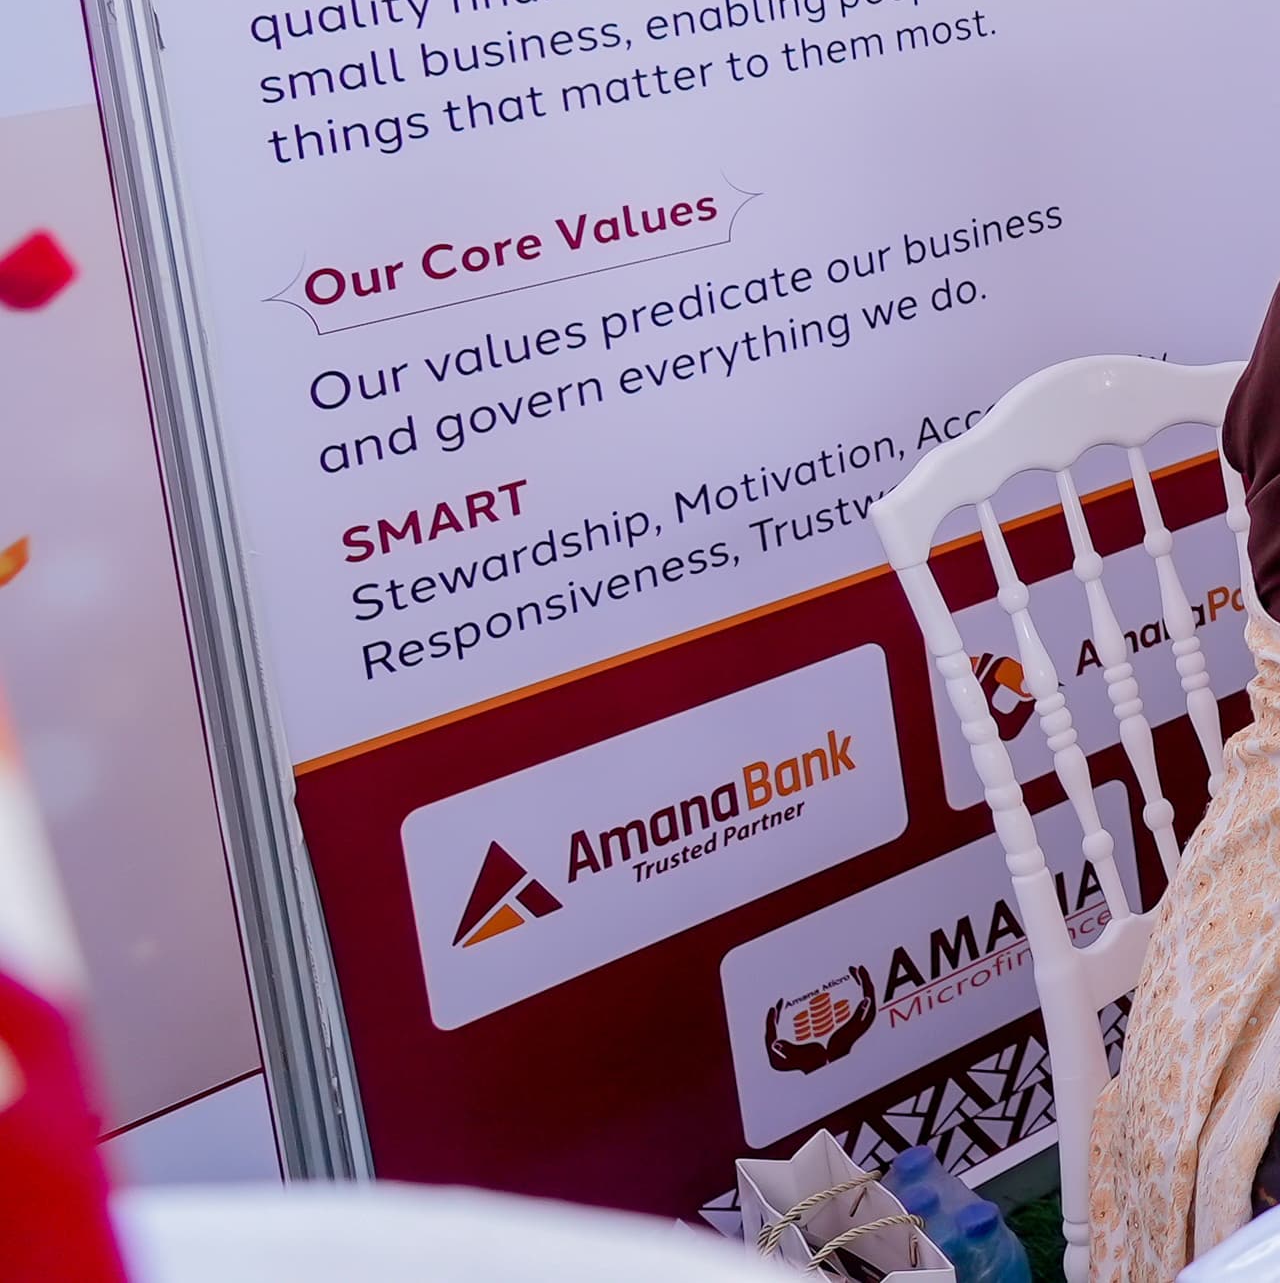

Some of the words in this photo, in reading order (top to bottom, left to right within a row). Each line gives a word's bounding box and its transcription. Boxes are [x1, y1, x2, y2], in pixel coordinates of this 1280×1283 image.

[261, 48, 405, 103] small
[421, 23, 631, 77] business,
[268, 113, 429, 163] things
[443, 87, 546, 131] that
[562, 62, 712, 111] matter
[726, 53, 768, 81] to
[781, 34, 883, 71] them
[897, 11, 995, 51] most.
[305, 262, 403, 305] Our
[422, 235, 541, 279] Core
[555, 197, 717, 250] Values
[311, 363, 408, 409] Our
[424, 323, 586, 382] values
[602, 268, 812, 349] predicate
[828, 247, 890, 283] our
[904, 207, 1062, 265] business
[320, 415, 417, 473] and
[436, 378, 602, 452] govern
[620, 306, 850, 394] everything
[862, 297, 917, 329] we
[932, 278, 986, 311] do.
[343, 479, 527, 564] SMART
[354, 506, 661, 622] Stewardship,
[675, 438, 904, 524] Motivation,
[363, 540, 740, 680] Responsiveness,
[567, 731, 856, 884] AmanaBank
[632, 831, 717, 883] Trusted
[724, 802, 804, 846] Partner
